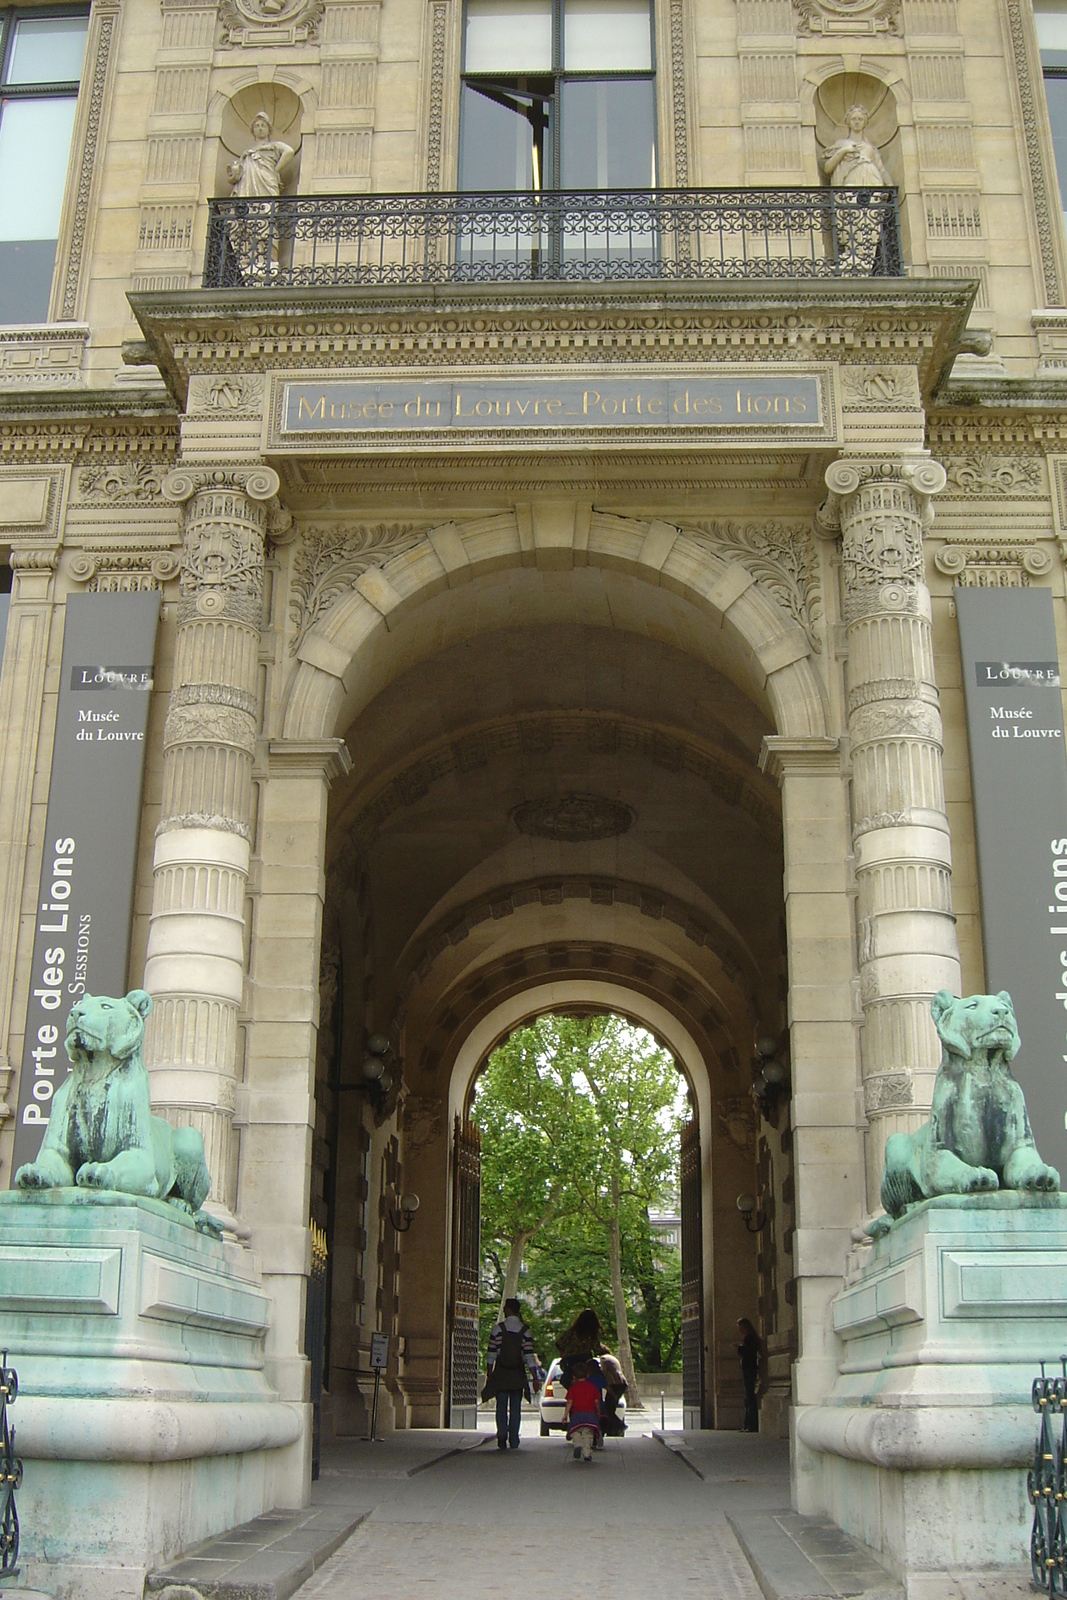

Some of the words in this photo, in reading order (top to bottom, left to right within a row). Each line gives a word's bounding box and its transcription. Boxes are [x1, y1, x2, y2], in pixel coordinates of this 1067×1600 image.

[404, 393, 441, 418] du
[673, 389, 723, 415] des
[735, 389, 807, 414] lions
[78, 709, 120, 722] Musée
[990, 706, 1033, 719] Musée
[76, 728, 93, 741] du
[96, 728, 144, 741] Louvre
[991, 725, 1010, 738] du
[1012, 725, 1062, 738] Louvre
[39, 836, 76, 933] Lions
[33, 946, 66, 1011] des
[22, 1024, 59, 1126] Porte
